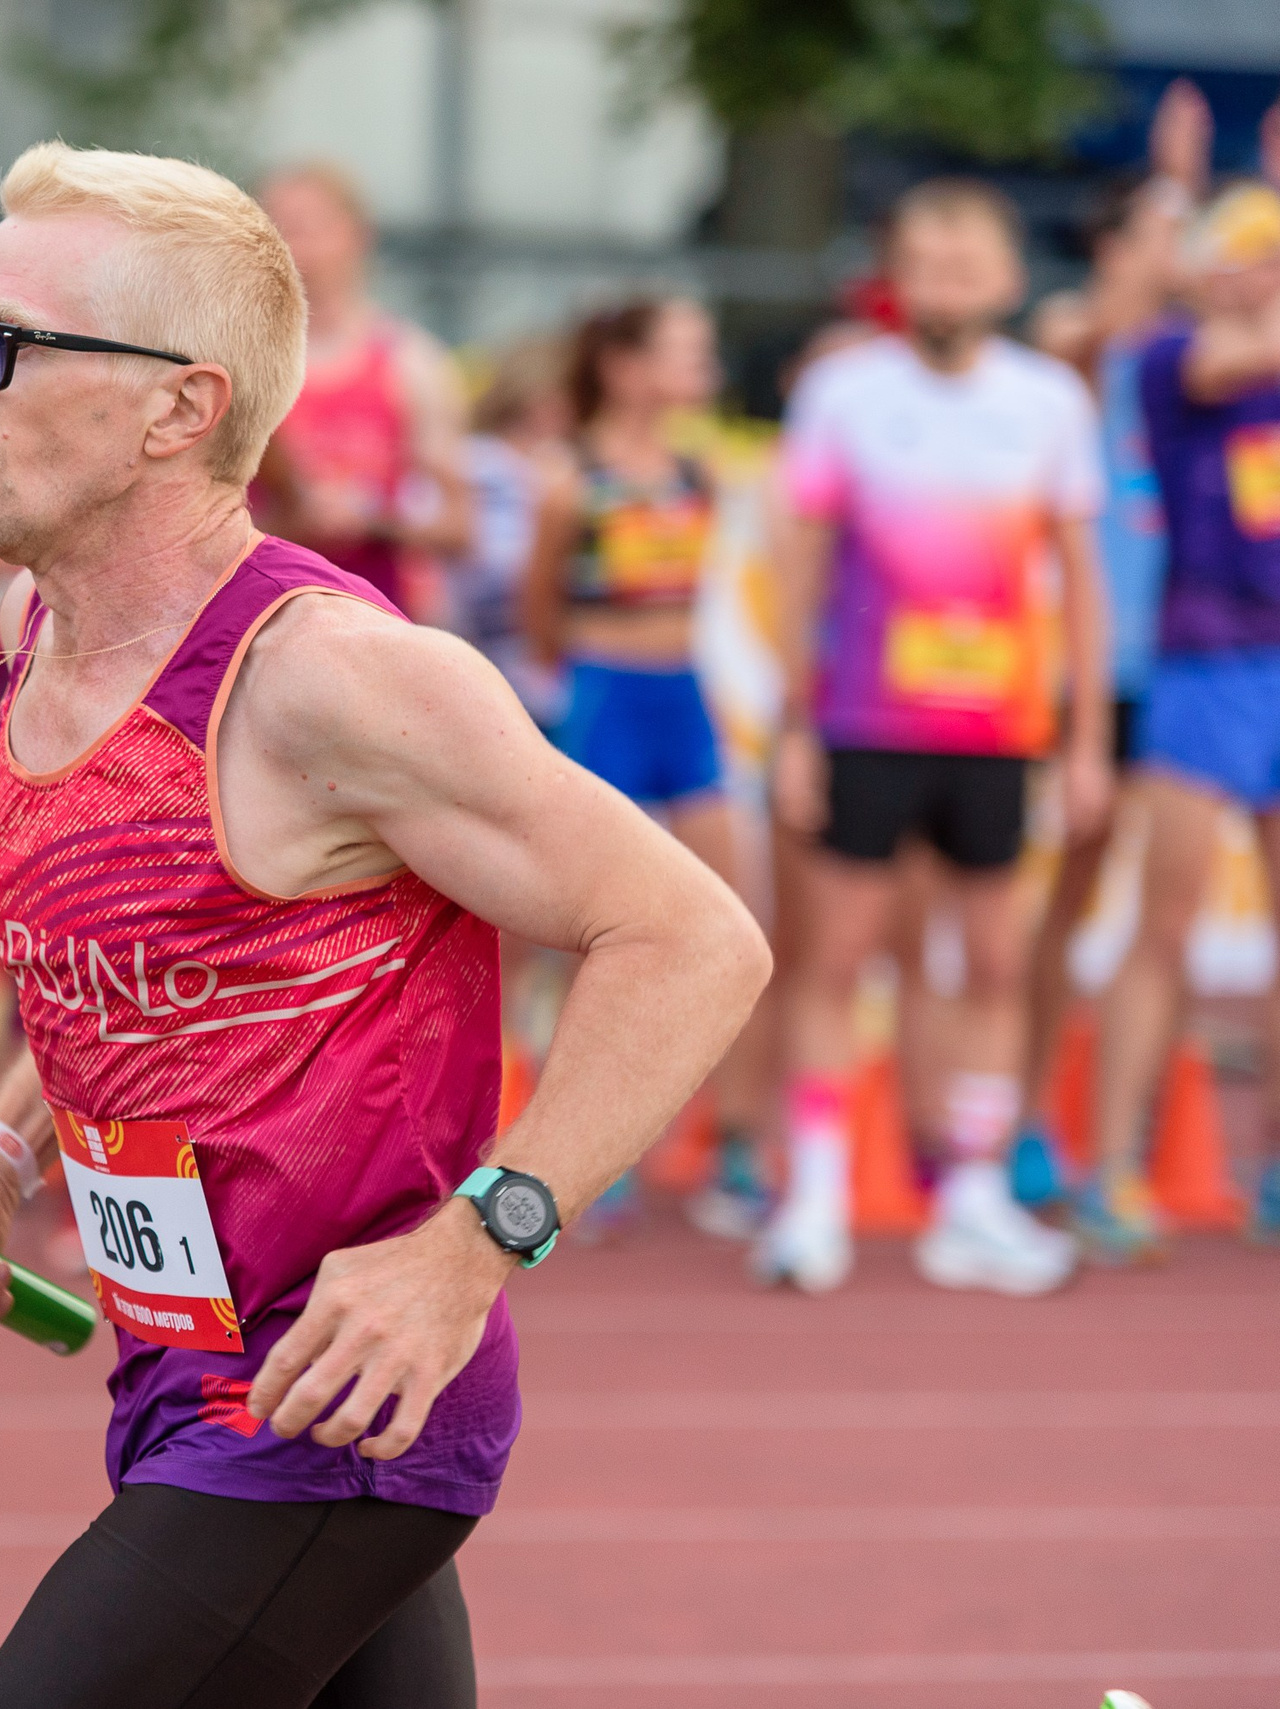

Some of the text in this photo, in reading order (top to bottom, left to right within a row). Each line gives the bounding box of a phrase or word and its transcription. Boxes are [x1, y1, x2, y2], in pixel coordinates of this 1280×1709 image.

[89, 1190, 196, 1276] 206 1
[152, 1311, 195, 1333] метров
